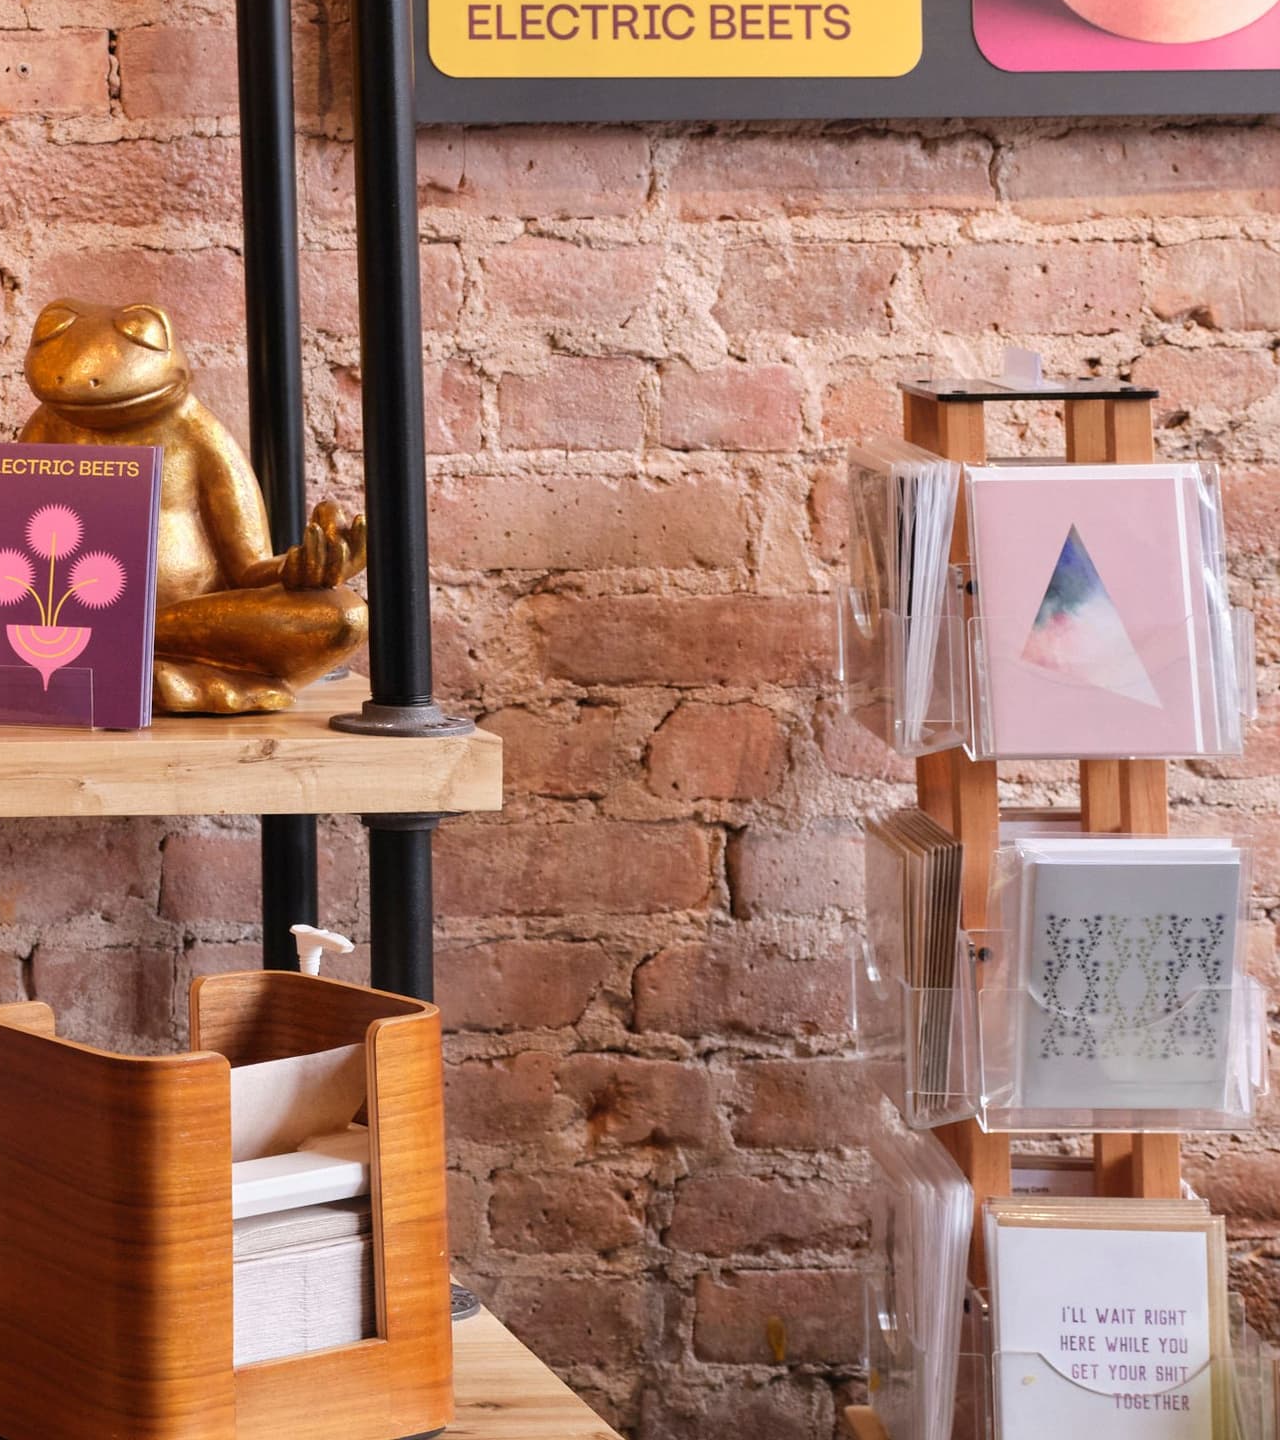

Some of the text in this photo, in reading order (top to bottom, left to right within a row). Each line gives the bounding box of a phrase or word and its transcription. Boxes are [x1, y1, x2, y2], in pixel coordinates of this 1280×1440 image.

[467, 2, 852, 41] ELECTRIC BEETS
[79, 460, 140, 478] BEETS
[1061, 1305, 1188, 1326] I'LL WAIT RIGHT
[1060, 1335, 1189, 1354] HERE WHILE YOU
[1071, 1363, 1189, 1383] GET YOUR SHIT
[1113, 1392, 1190, 1411] TOGETHER
